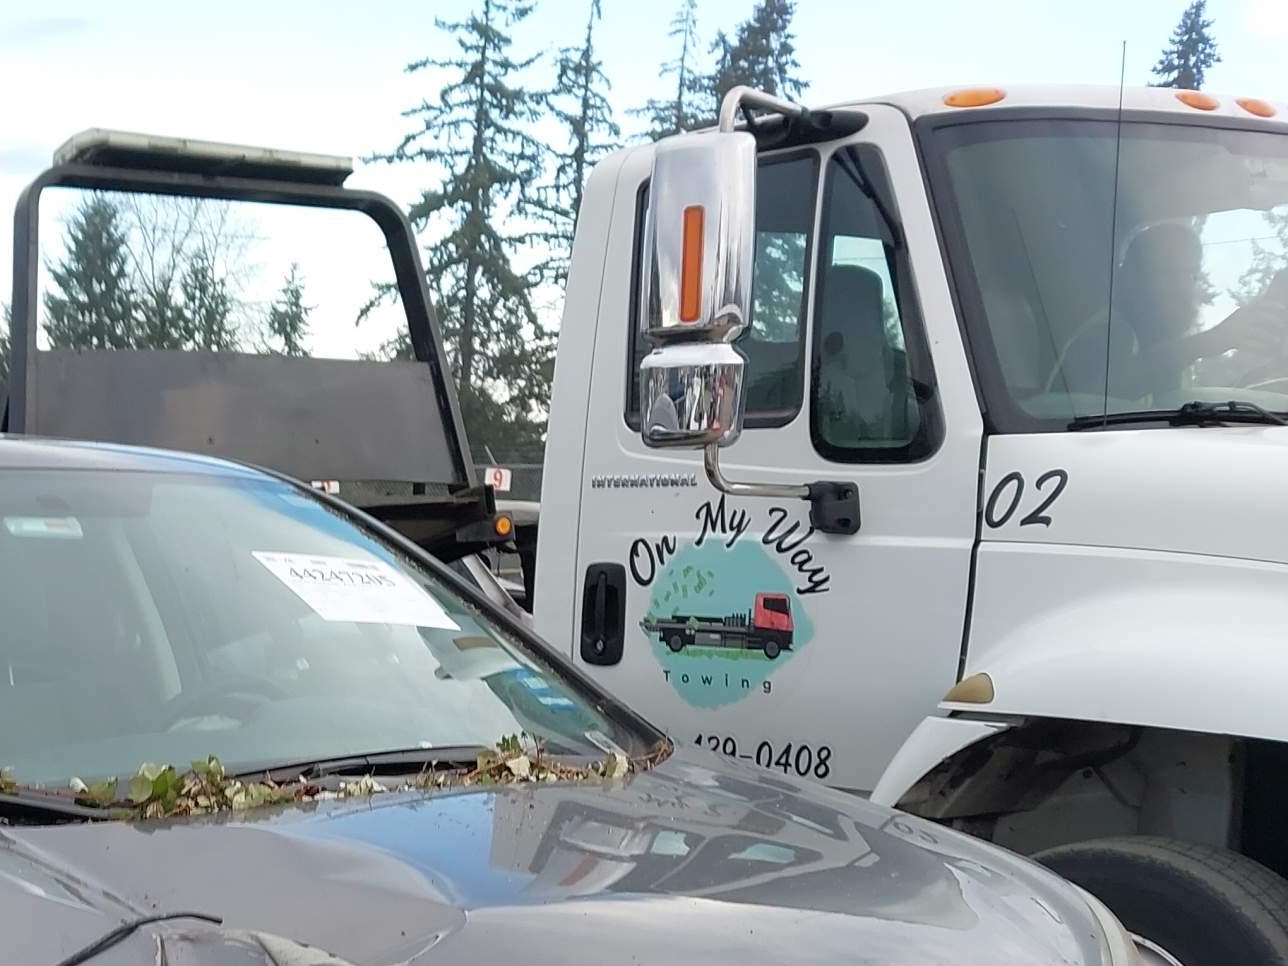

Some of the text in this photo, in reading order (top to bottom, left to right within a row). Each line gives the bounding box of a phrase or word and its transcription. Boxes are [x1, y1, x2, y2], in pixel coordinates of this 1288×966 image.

[493, 469, 503, 489] 9
[591, 473, 698, 488] INTERNATIONAL
[985, 469, 1068, 529] 02
[629, 496, 830, 595] On My Way
[663, 669, 772, 694] Towing
